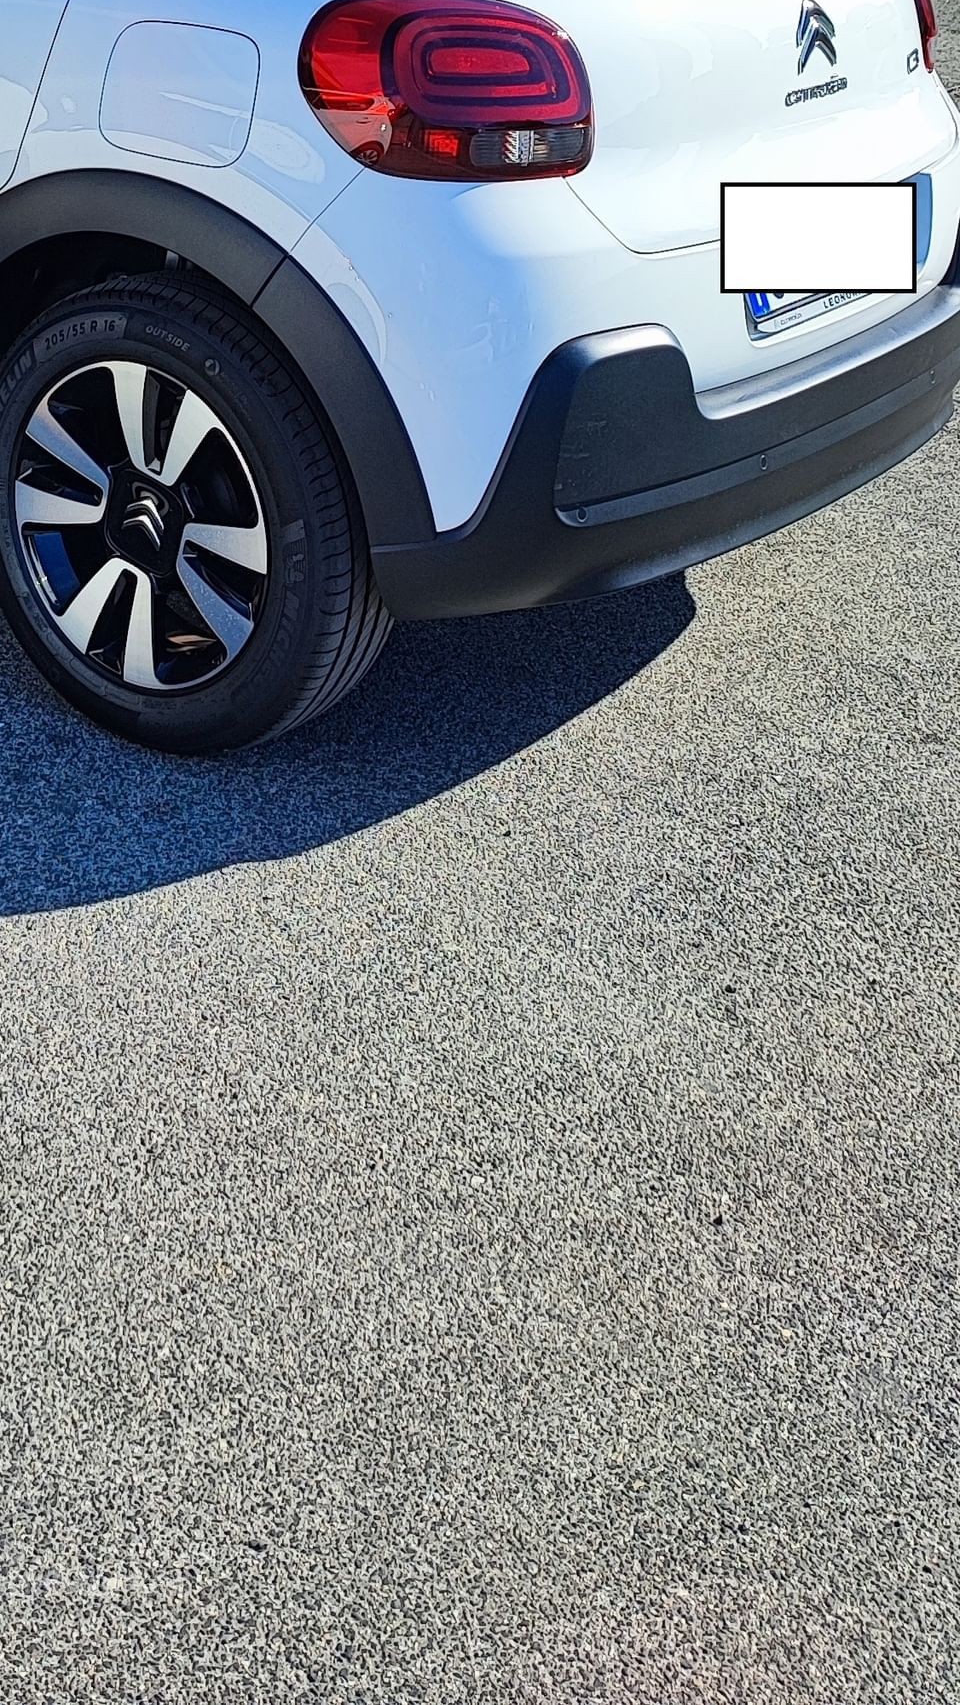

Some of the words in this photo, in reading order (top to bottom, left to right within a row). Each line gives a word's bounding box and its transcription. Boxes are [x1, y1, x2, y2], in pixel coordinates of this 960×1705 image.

[44, 323, 86, 349] 205/55
[89, 319, 98, 333] R
[145, 325, 191, 353] OUTSIDE
